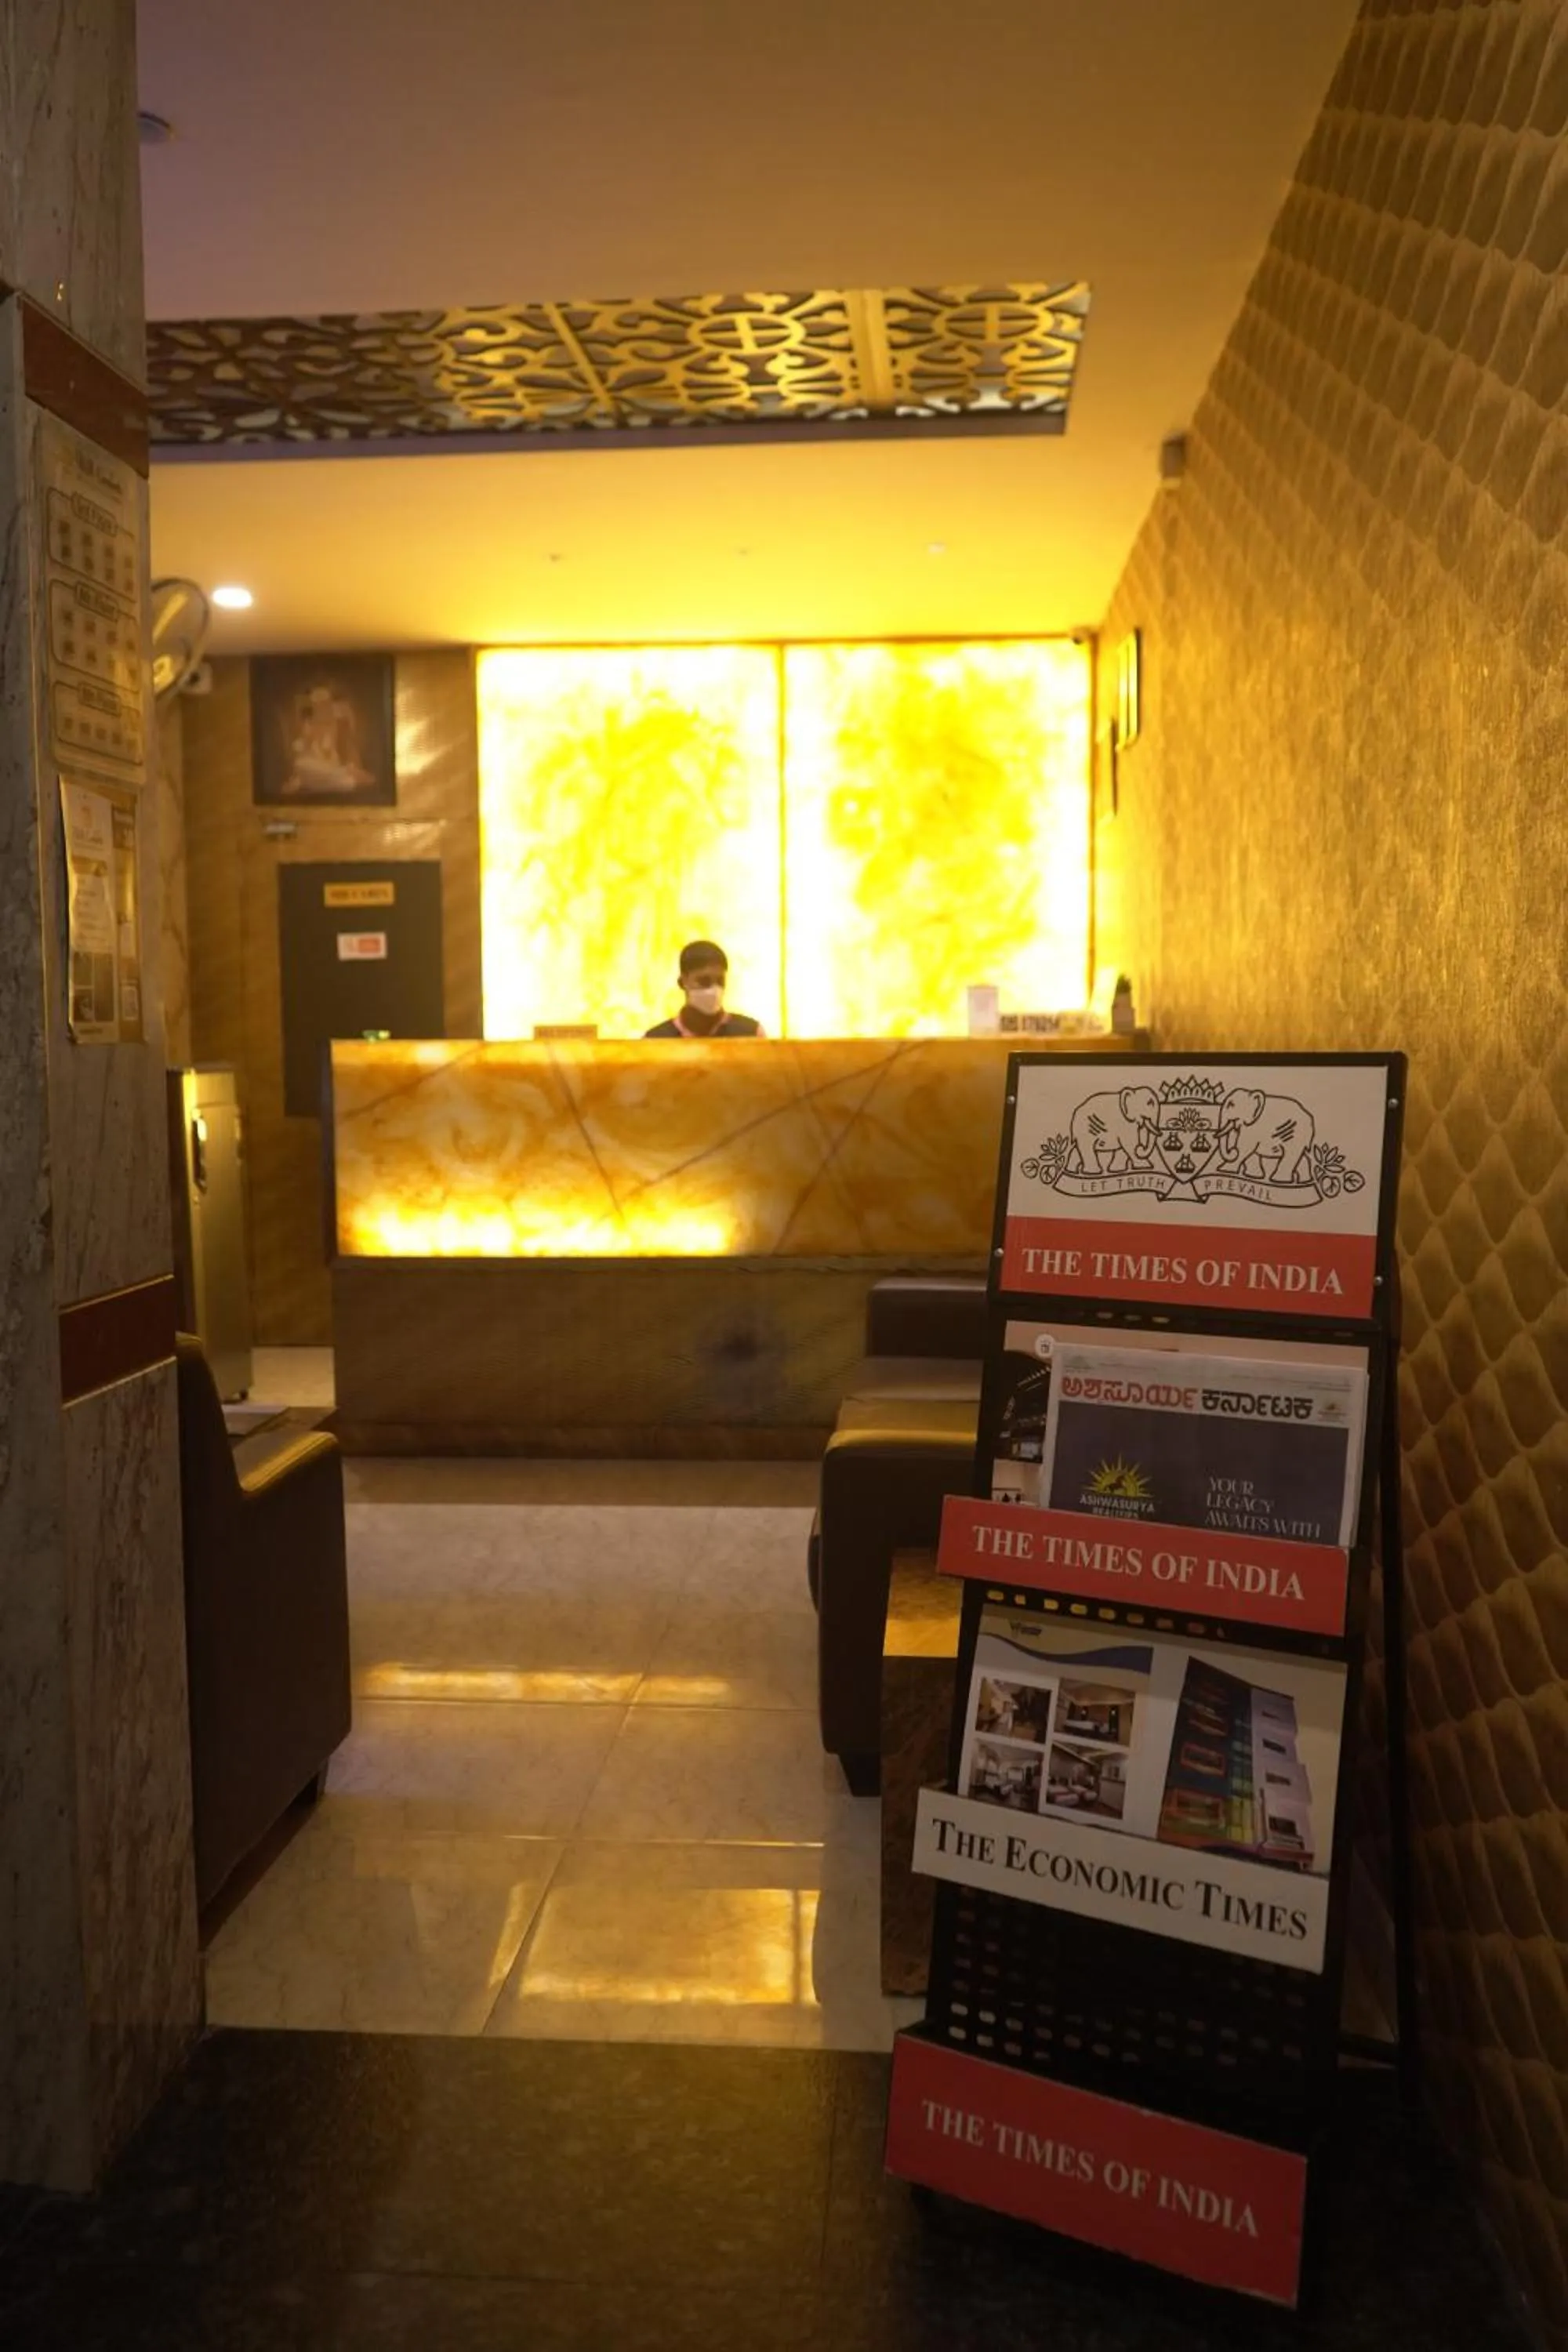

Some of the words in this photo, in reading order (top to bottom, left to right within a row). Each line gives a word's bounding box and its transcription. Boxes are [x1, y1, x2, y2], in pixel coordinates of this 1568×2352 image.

[1080, 1179, 1108, 1192] LET
[1116, 1177, 1166, 1189] TRUTH
[1204, 1180, 1272, 1200] PREVAIL
[1022, 1248, 1082, 1278] THE
[1091, 1253, 1188, 1284] TIMES
[1196, 1258, 1241, 1289] OF
[1247, 1262, 1345, 1295] INDIA
[1202, 1388, 1314, 1421] ಕರ್ನಾಟಕ
[1209, 1475, 1254, 1496] YOUR
[1079, 1494, 1156, 1514] ASHWASURYA
[1206, 1492, 1275, 1514] LEGACY
[1204, 1510, 1269, 1532] AWAITS
[1273, 1519, 1321, 1538] WITH
[972, 1525, 1035, 1559] THE
[1043, 1534, 1144, 1577] TIMES
[1151, 1552, 1198, 1585] OF
[1206, 1559, 1305, 1601] INDIA
[931, 1817, 995, 1865] THE
[1004, 1835, 1185, 1911] ECONOMIC
[1194, 1880, 1308, 1941] TIMES
[921, 2098, 985, 2148] THE
[993, 2122, 1095, 2183] TIMES
[1103, 2160, 1151, 2199] OF
[1157, 2175, 1259, 2238] INDIA
